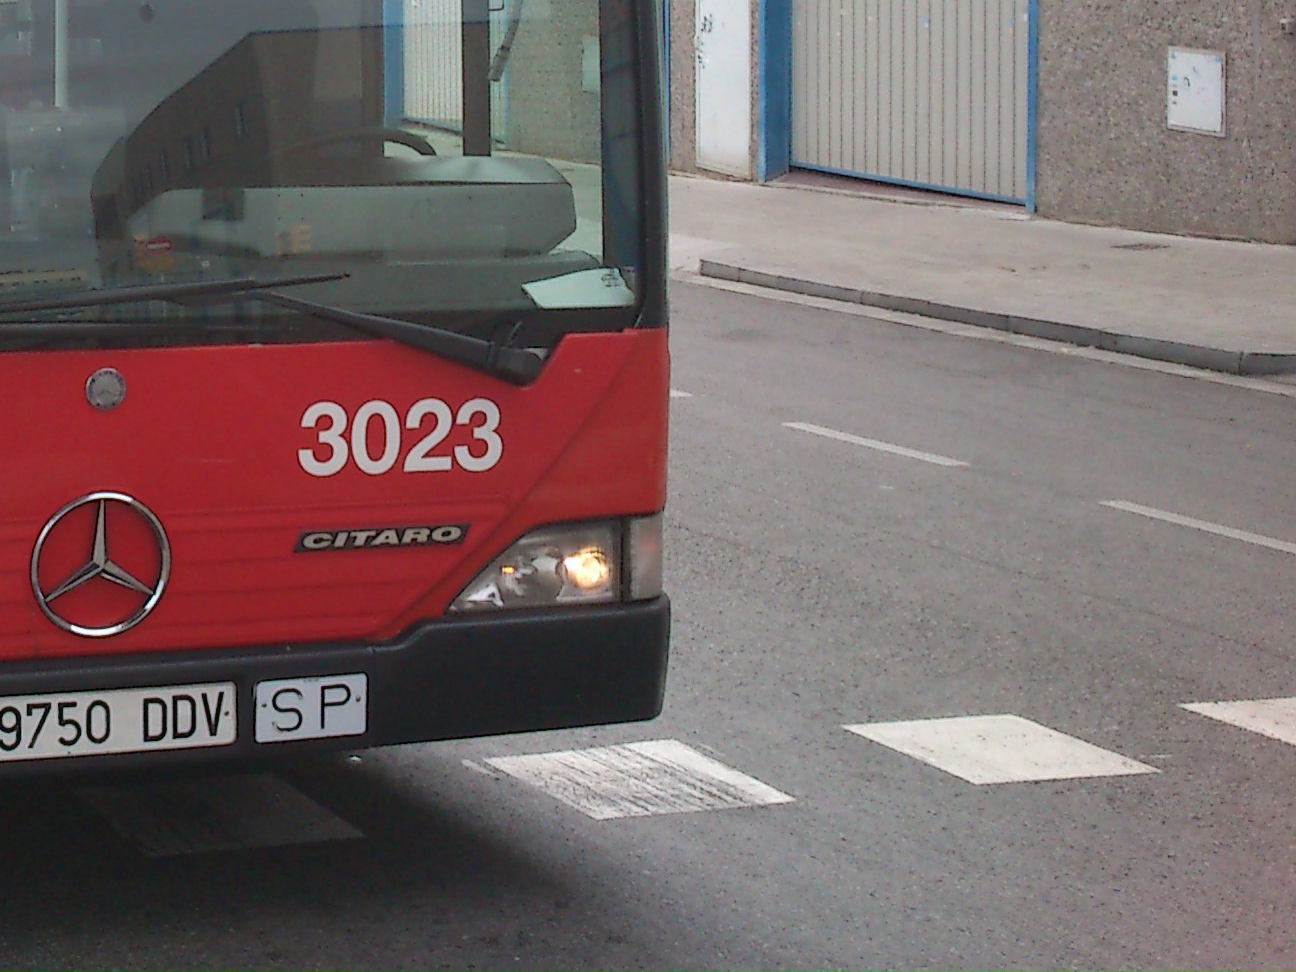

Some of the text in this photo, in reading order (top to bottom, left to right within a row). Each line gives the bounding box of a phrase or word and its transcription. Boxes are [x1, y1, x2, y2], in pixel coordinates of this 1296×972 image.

[298, 397, 503, 477] 3023
[302, 526, 462, 549] CITARO
[142, 691, 226, 743] DDV
